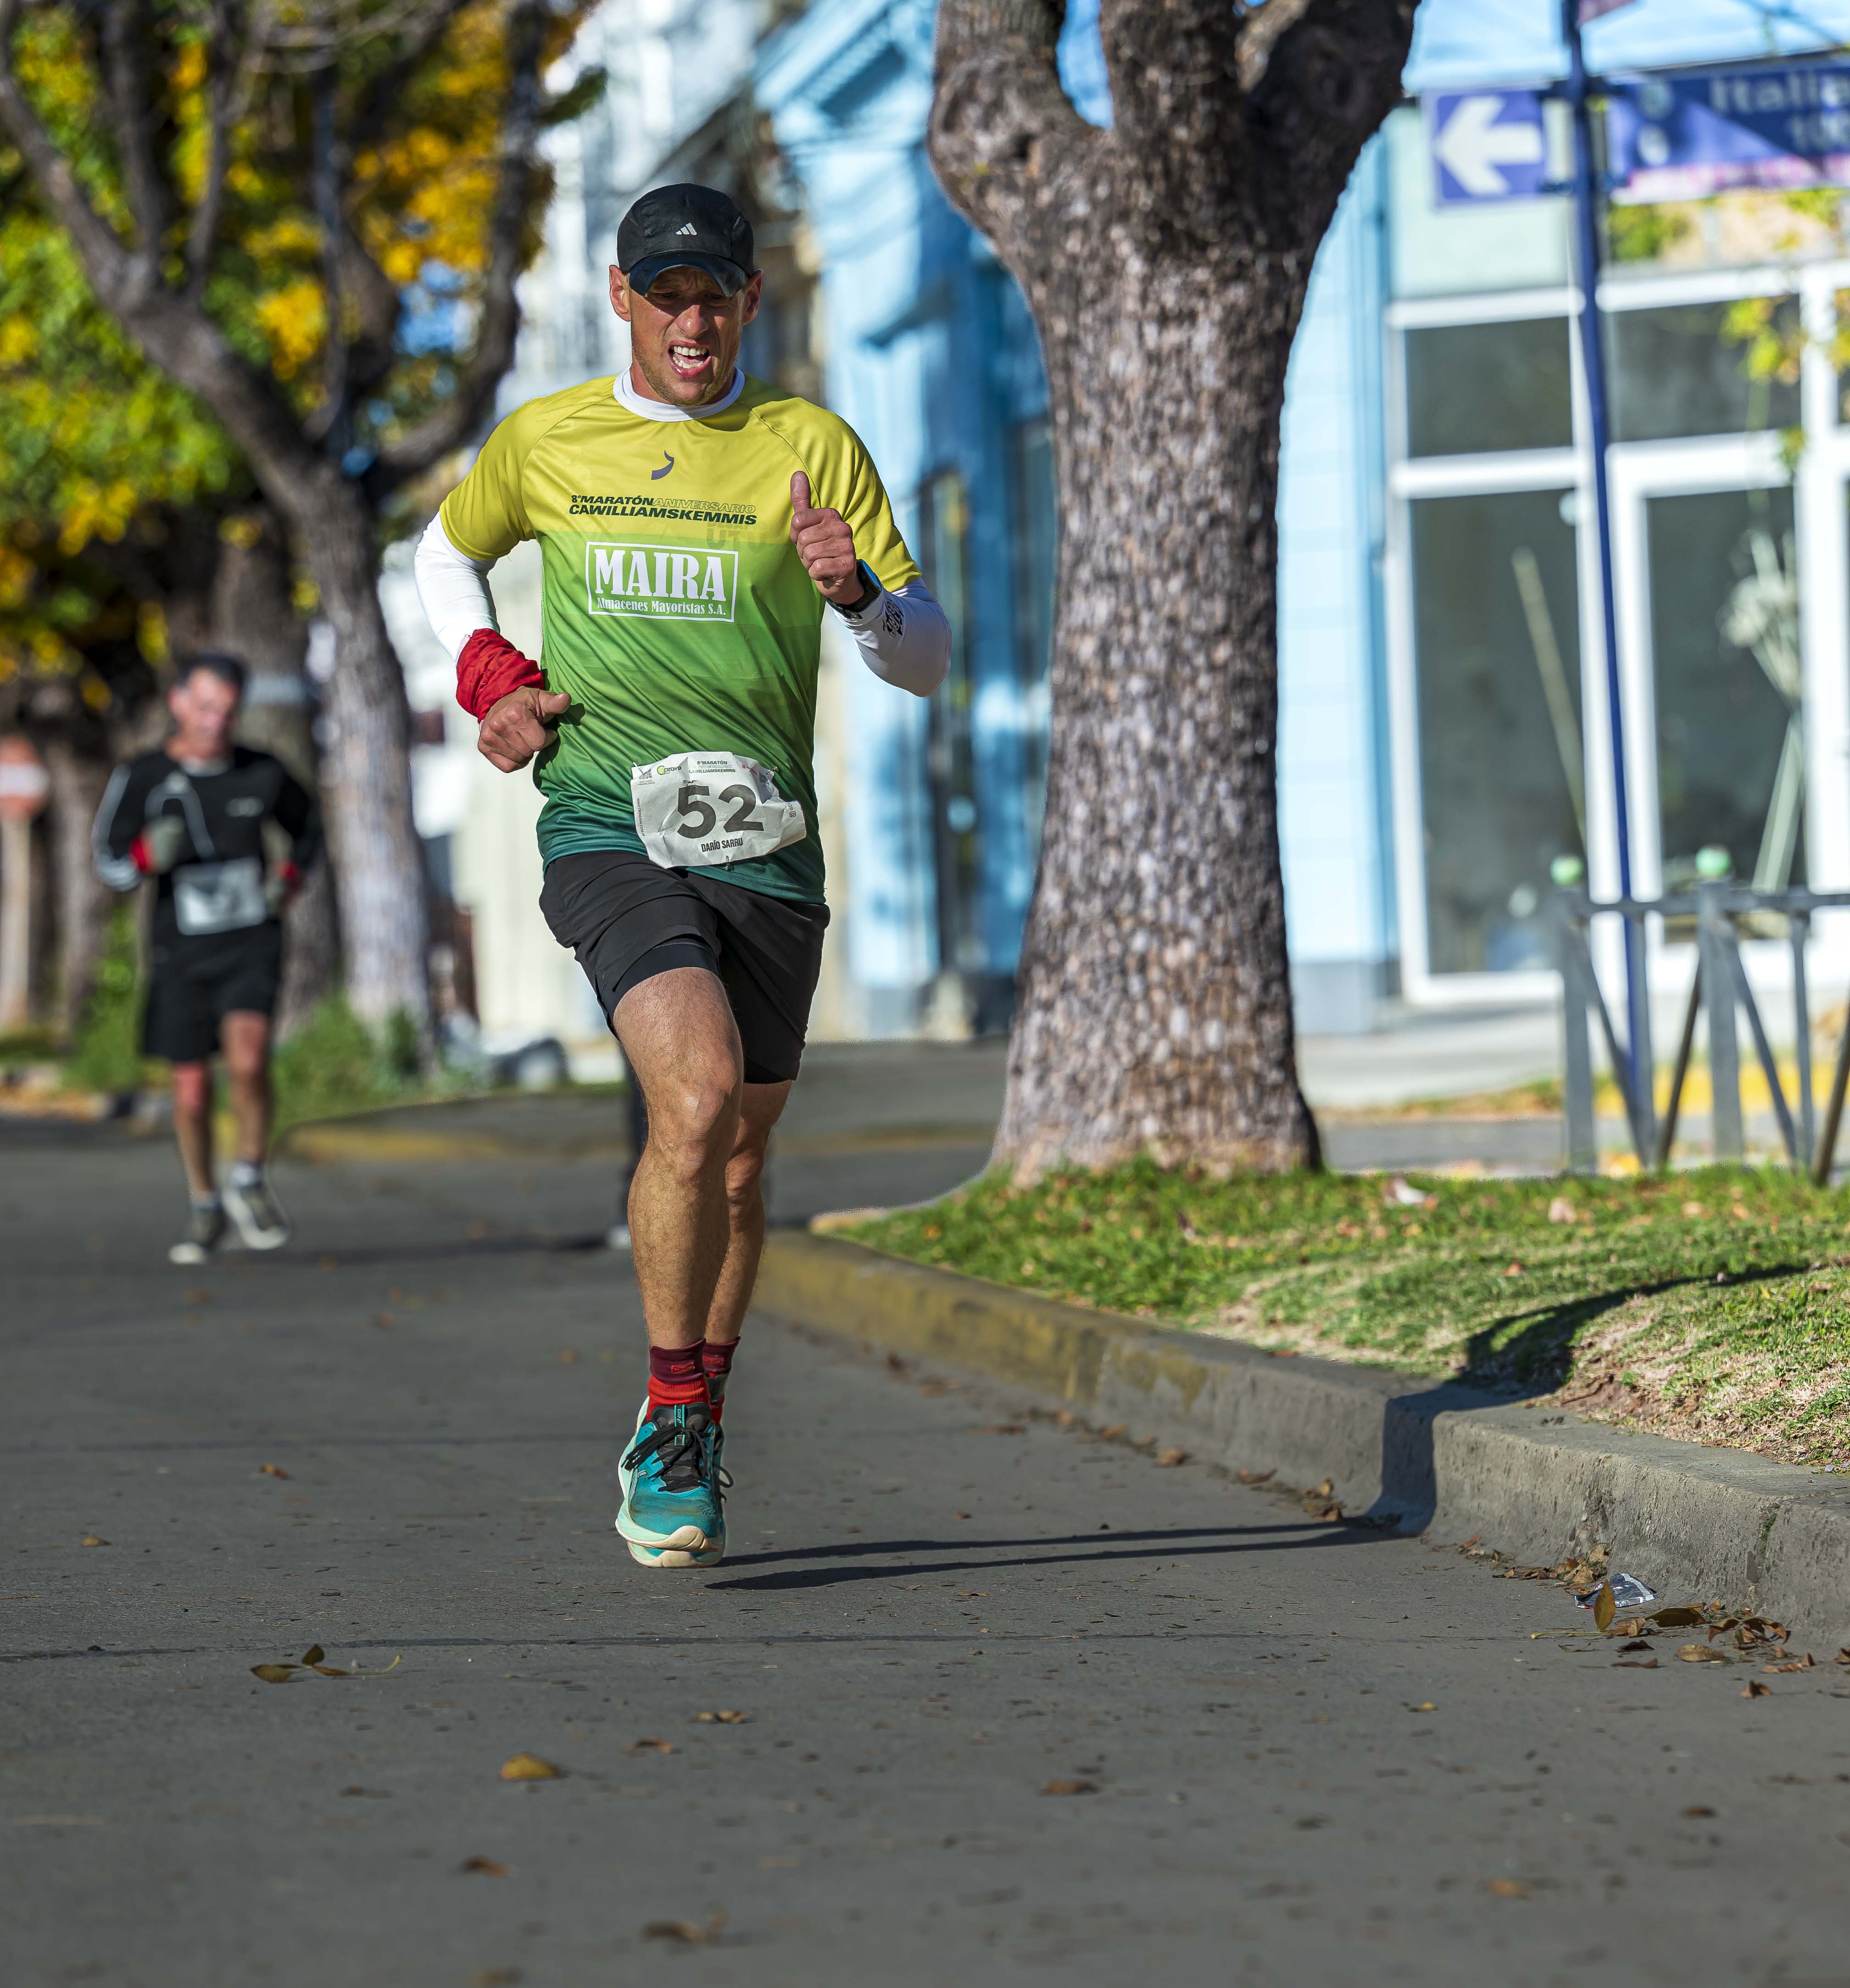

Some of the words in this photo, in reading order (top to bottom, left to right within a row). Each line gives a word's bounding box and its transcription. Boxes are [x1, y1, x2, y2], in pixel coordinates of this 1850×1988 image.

[653, 498, 756, 513] ANIVERSARIO
[594, 549, 726, 601] MAIRA
[597, 597, 648, 612] Almacenes
[651, 601, 705, 614] Mayoristas
[708, 603, 726, 615] S.A.
[677, 784, 764, 839] 52
[701, 840, 721, 852] DARÍO
[721, 837, 743, 849] SARRU
